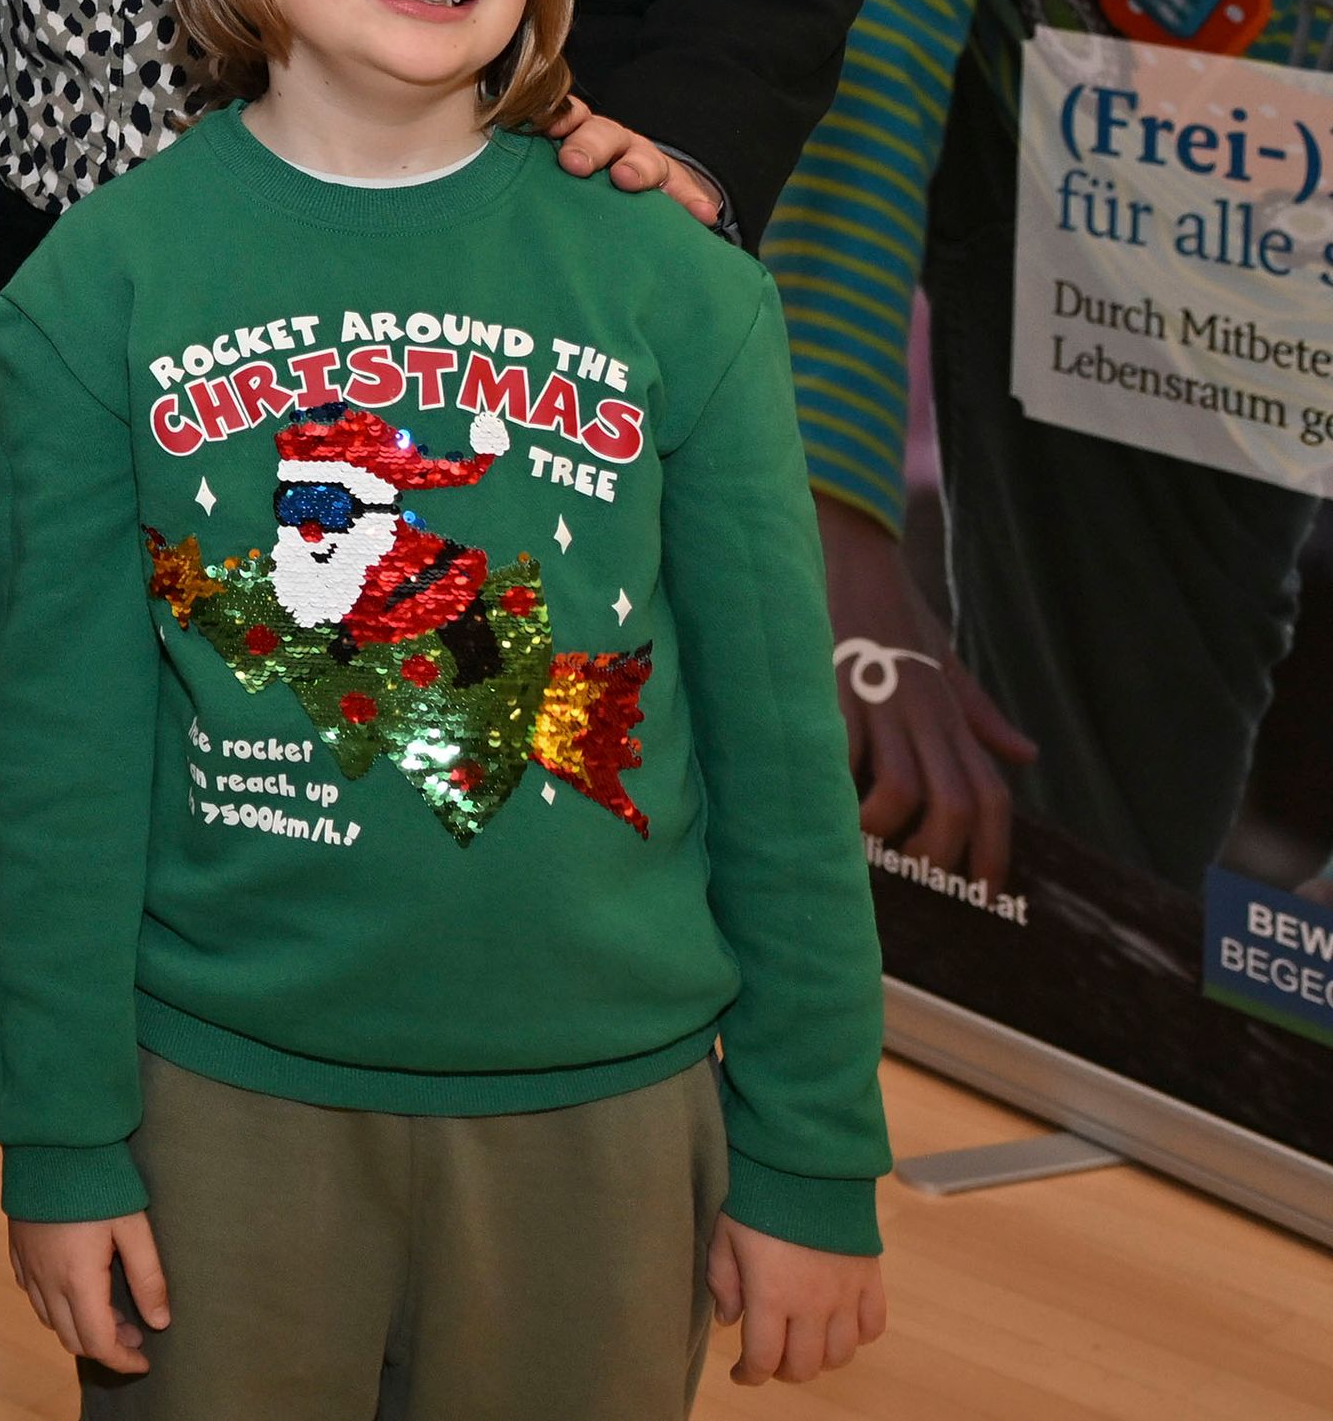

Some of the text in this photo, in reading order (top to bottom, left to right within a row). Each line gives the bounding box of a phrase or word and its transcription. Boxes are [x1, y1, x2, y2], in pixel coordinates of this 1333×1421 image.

[1060, 83, 1333, 204] (Frei-)
[1056, 169, 1155, 246] für
[1174, 198, 1294, 276] alle
[1053, 279, 1166, 341] Durch
[149, 311, 630, 393] ROCKET AROUND THE
[1051, 335, 1287, 428] Lebensraum
[149, 345, 645, 464] CHRISTMAS
[528, 445, 619, 503] TREE
[222, 738, 314, 763] rocket
[200, 802, 361, 846] 7500km/h!
[216, 774, 296, 797] reach
[305, 782, 339, 808] up
